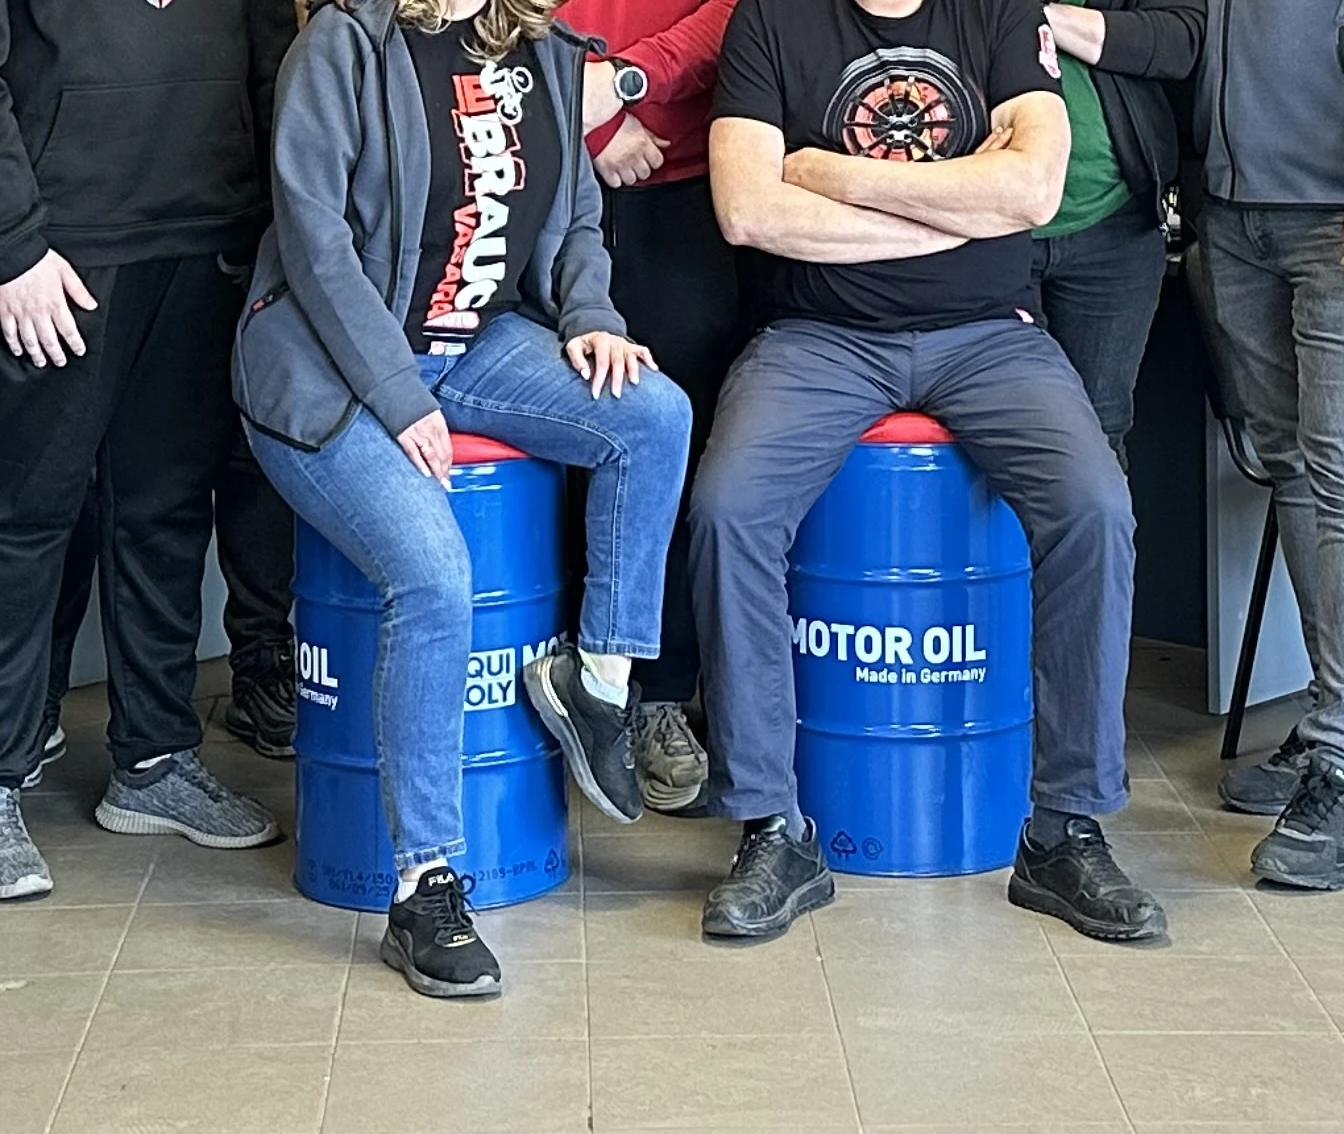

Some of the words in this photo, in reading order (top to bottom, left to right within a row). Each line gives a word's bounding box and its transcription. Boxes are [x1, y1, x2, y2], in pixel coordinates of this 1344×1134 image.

[790, 617, 913, 664] MOTOR
[923, 624, 986, 663] OIL
[300, 642, 339, 688] OIL
[856, 667, 897, 684] Made
[901, 668, 917, 684] in
[920, 667, 986, 684] Germany
